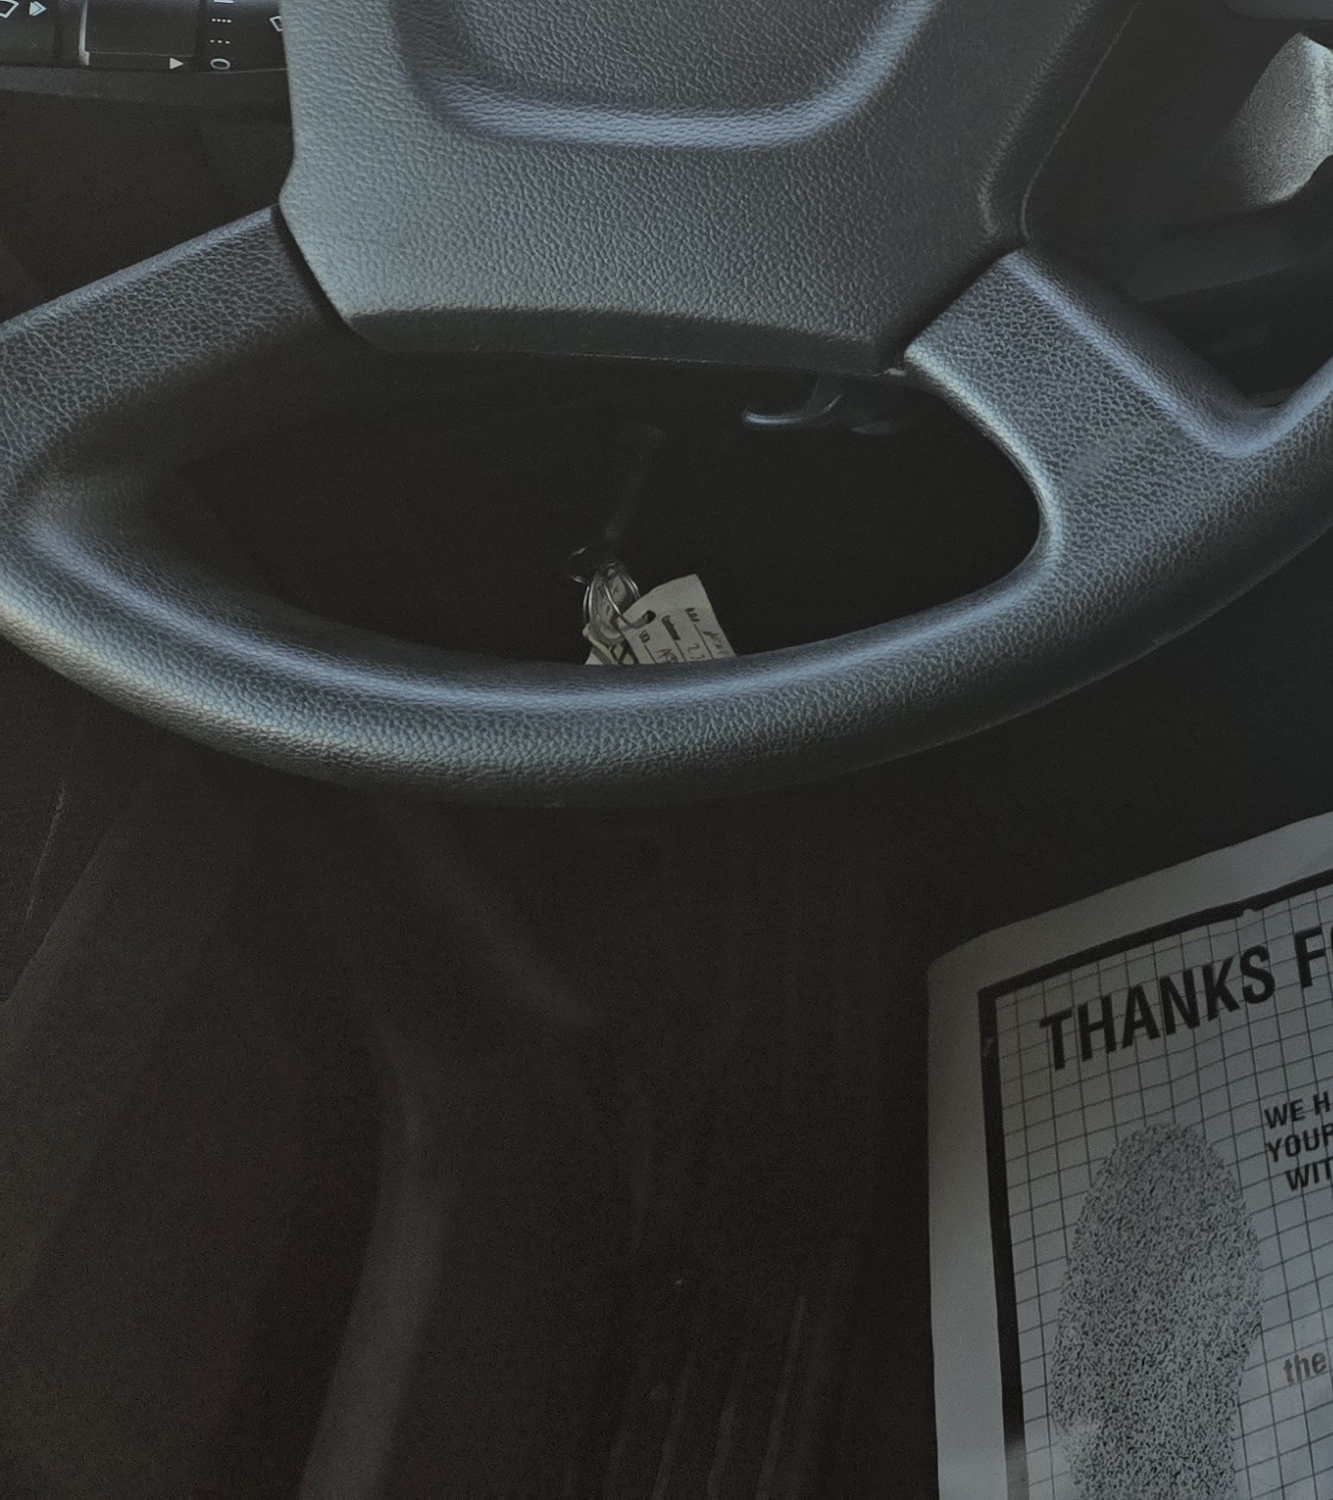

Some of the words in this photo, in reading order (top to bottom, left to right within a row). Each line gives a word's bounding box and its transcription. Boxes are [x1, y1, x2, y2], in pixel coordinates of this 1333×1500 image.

[1039, 944, 1276, 1072] THANKS
[1264, 1098, 1306, 1130] WE
[1284, 1349, 1328, 1386] the
